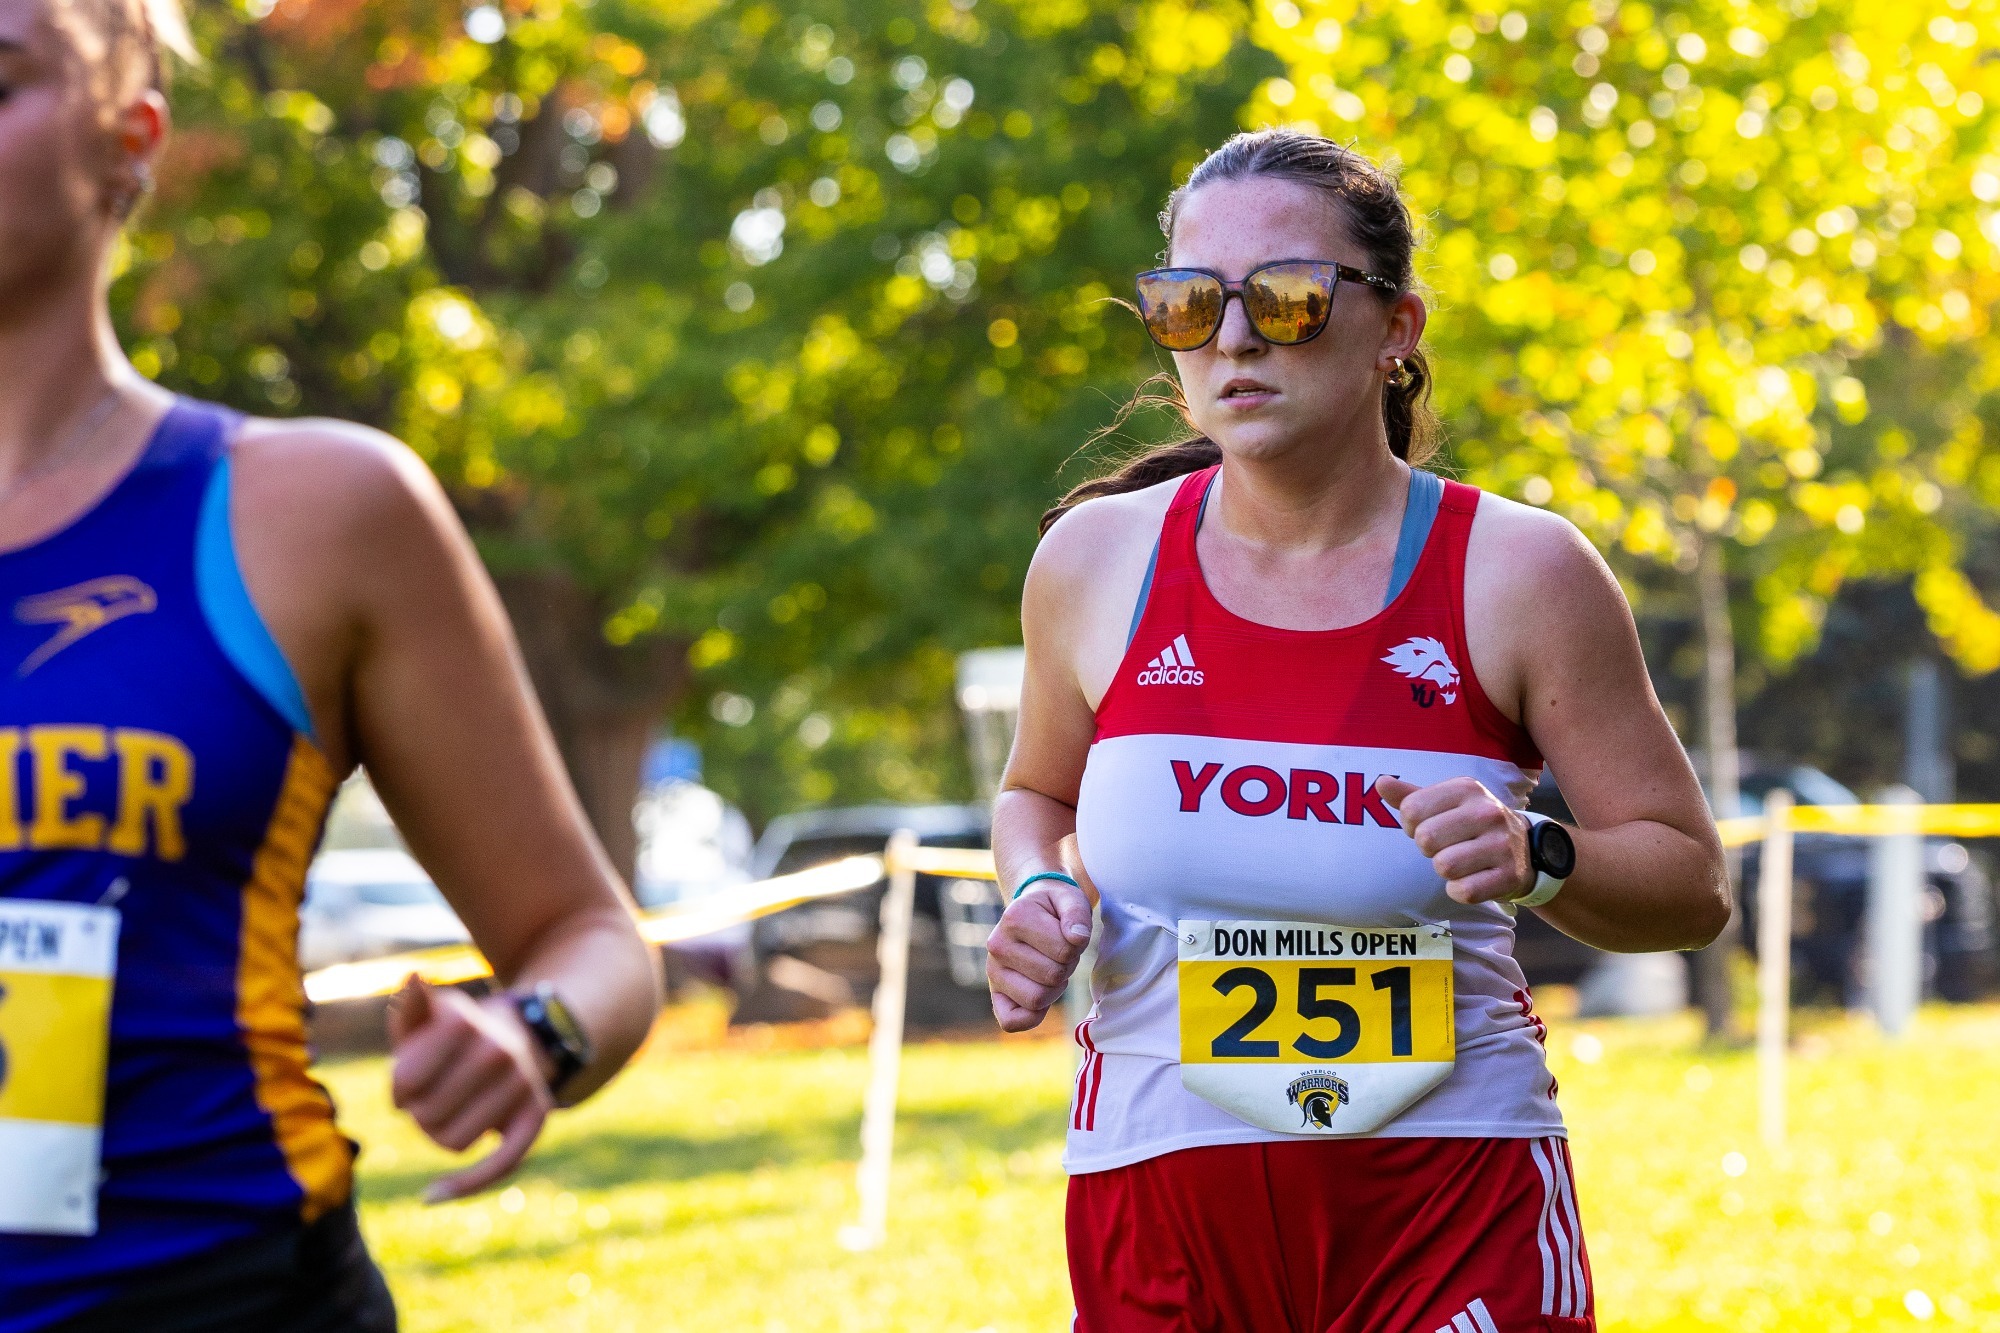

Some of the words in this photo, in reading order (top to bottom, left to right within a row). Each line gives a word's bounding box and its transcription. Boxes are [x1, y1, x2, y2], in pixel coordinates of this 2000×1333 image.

[1137, 665, 1205, 686] adidas
[1410, 683, 1436, 708] YU
[1170, 759, 1403, 830] YORK
[1214, 928, 1267, 957] DON
[1275, 929, 1344, 957] MILLS
[1351, 931, 1417, 956] OPEN
[1211, 966, 1413, 1060] 251
[1300, 1069, 1337, 1077] WATERLOO
[1286, 1077, 1349, 1105] WARRIORS
